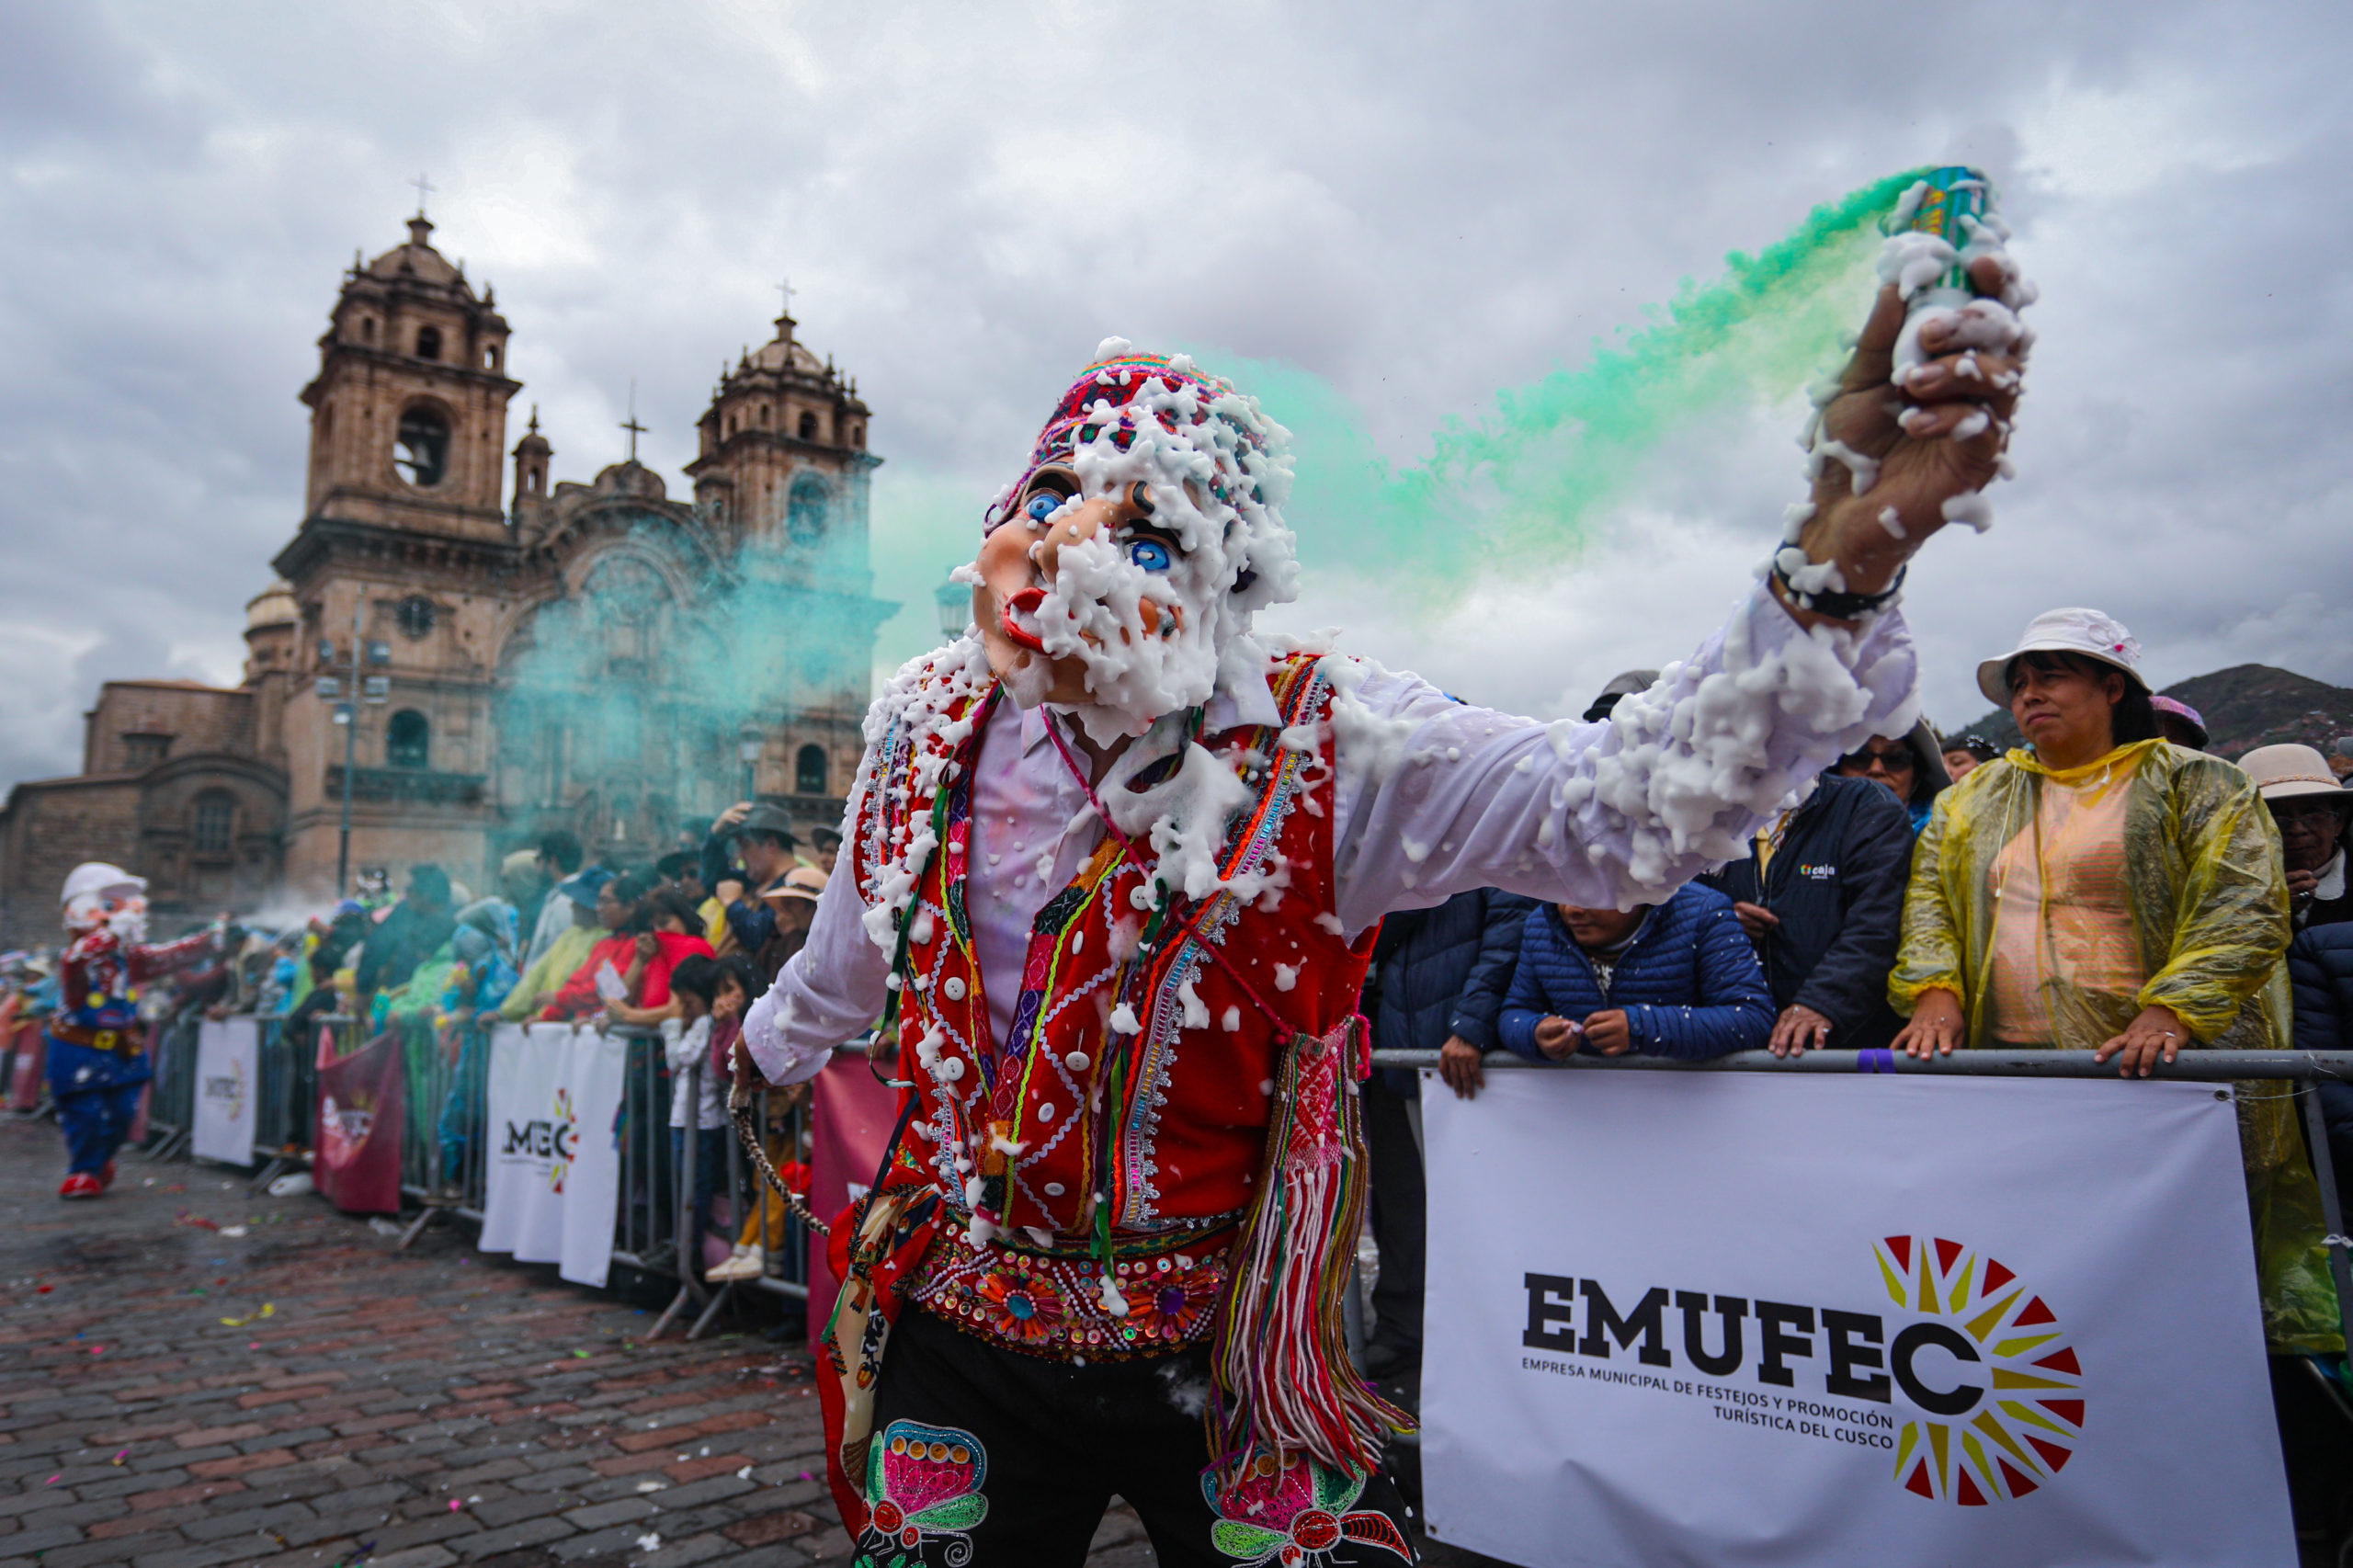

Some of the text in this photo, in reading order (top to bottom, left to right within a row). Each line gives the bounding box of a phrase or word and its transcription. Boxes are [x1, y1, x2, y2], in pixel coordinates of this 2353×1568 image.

[1812, 863, 1836, 876] caja
[1522, 1271, 1984, 1416] EMUFEC
[1521, 1357, 1893, 1430] EMPRESA MUNICIPAL DE FESTEJOS Y PROMOCIÓN
[1712, 1404, 1893, 1450] TURÍSTICA DEL CUSCO
